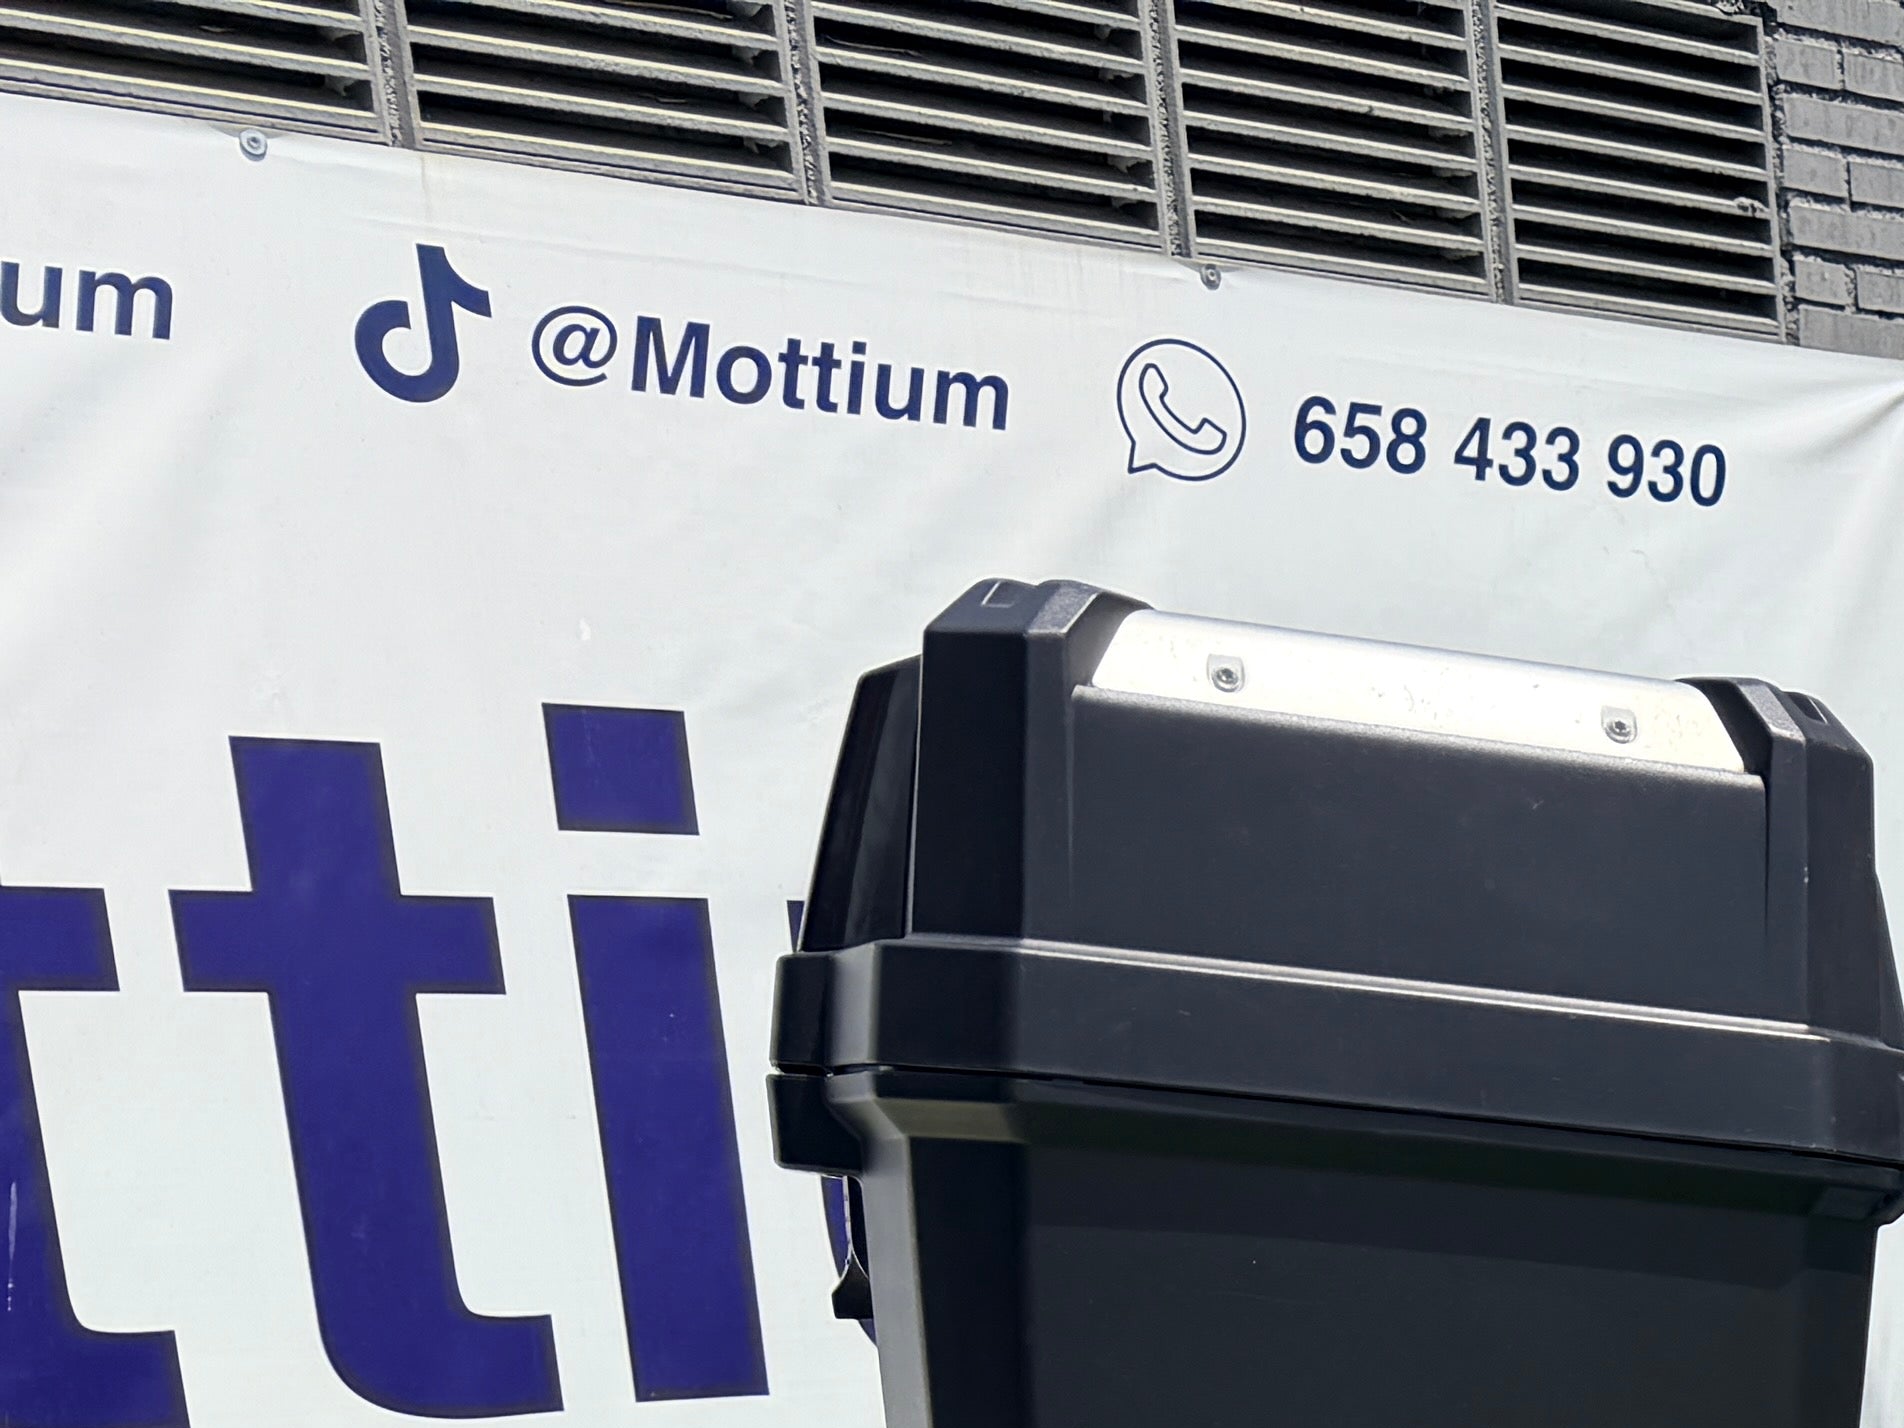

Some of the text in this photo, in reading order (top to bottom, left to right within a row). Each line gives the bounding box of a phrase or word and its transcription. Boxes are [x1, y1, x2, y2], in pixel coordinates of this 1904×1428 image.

[531, 304, 1009, 431] @Mottium
[1294, 395, 1726, 507] 658 433 930
